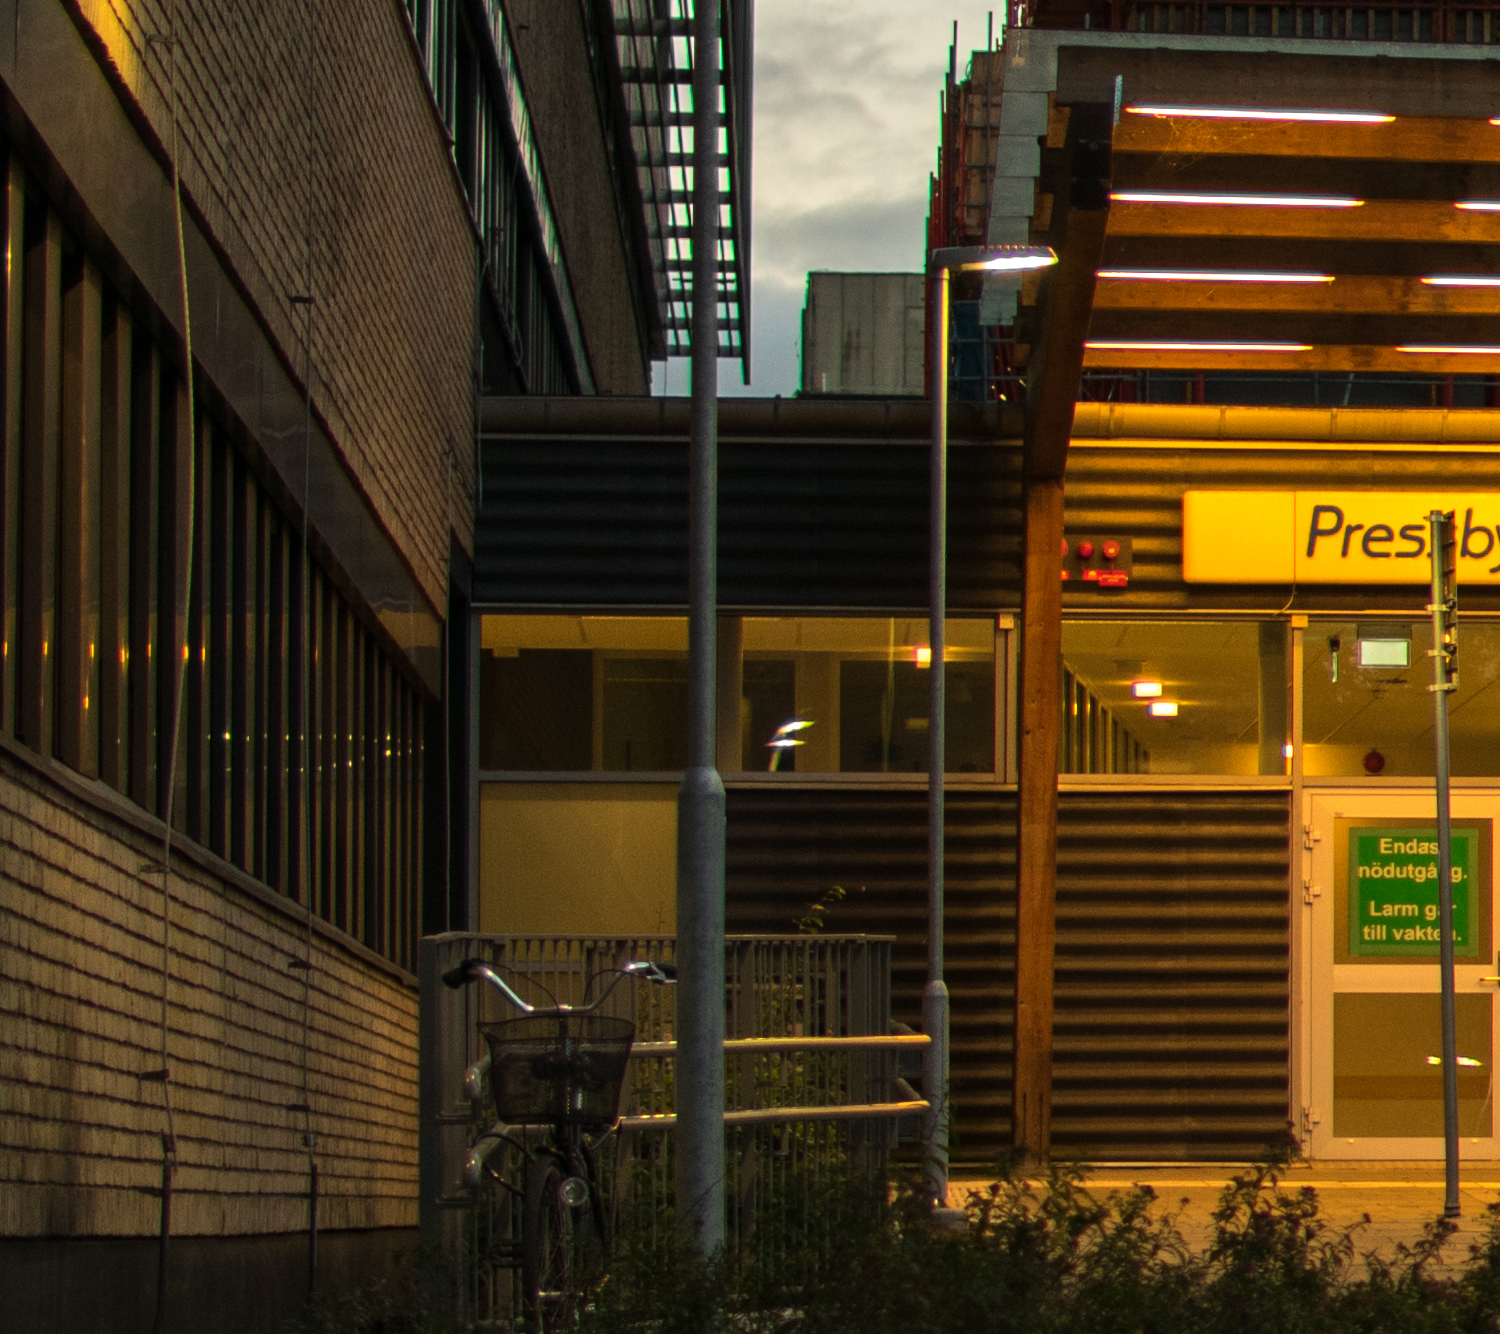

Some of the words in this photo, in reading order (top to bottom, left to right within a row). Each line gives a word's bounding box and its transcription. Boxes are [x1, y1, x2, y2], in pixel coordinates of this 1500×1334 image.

[1379, 838, 1440, 855] Endas
[1358, 862, 1468, 883] nödutgåg.
[1369, 900, 1419, 917] Larm
[1363, 924, 1387, 941] till
[1392, 924, 1462, 941] vakte.
